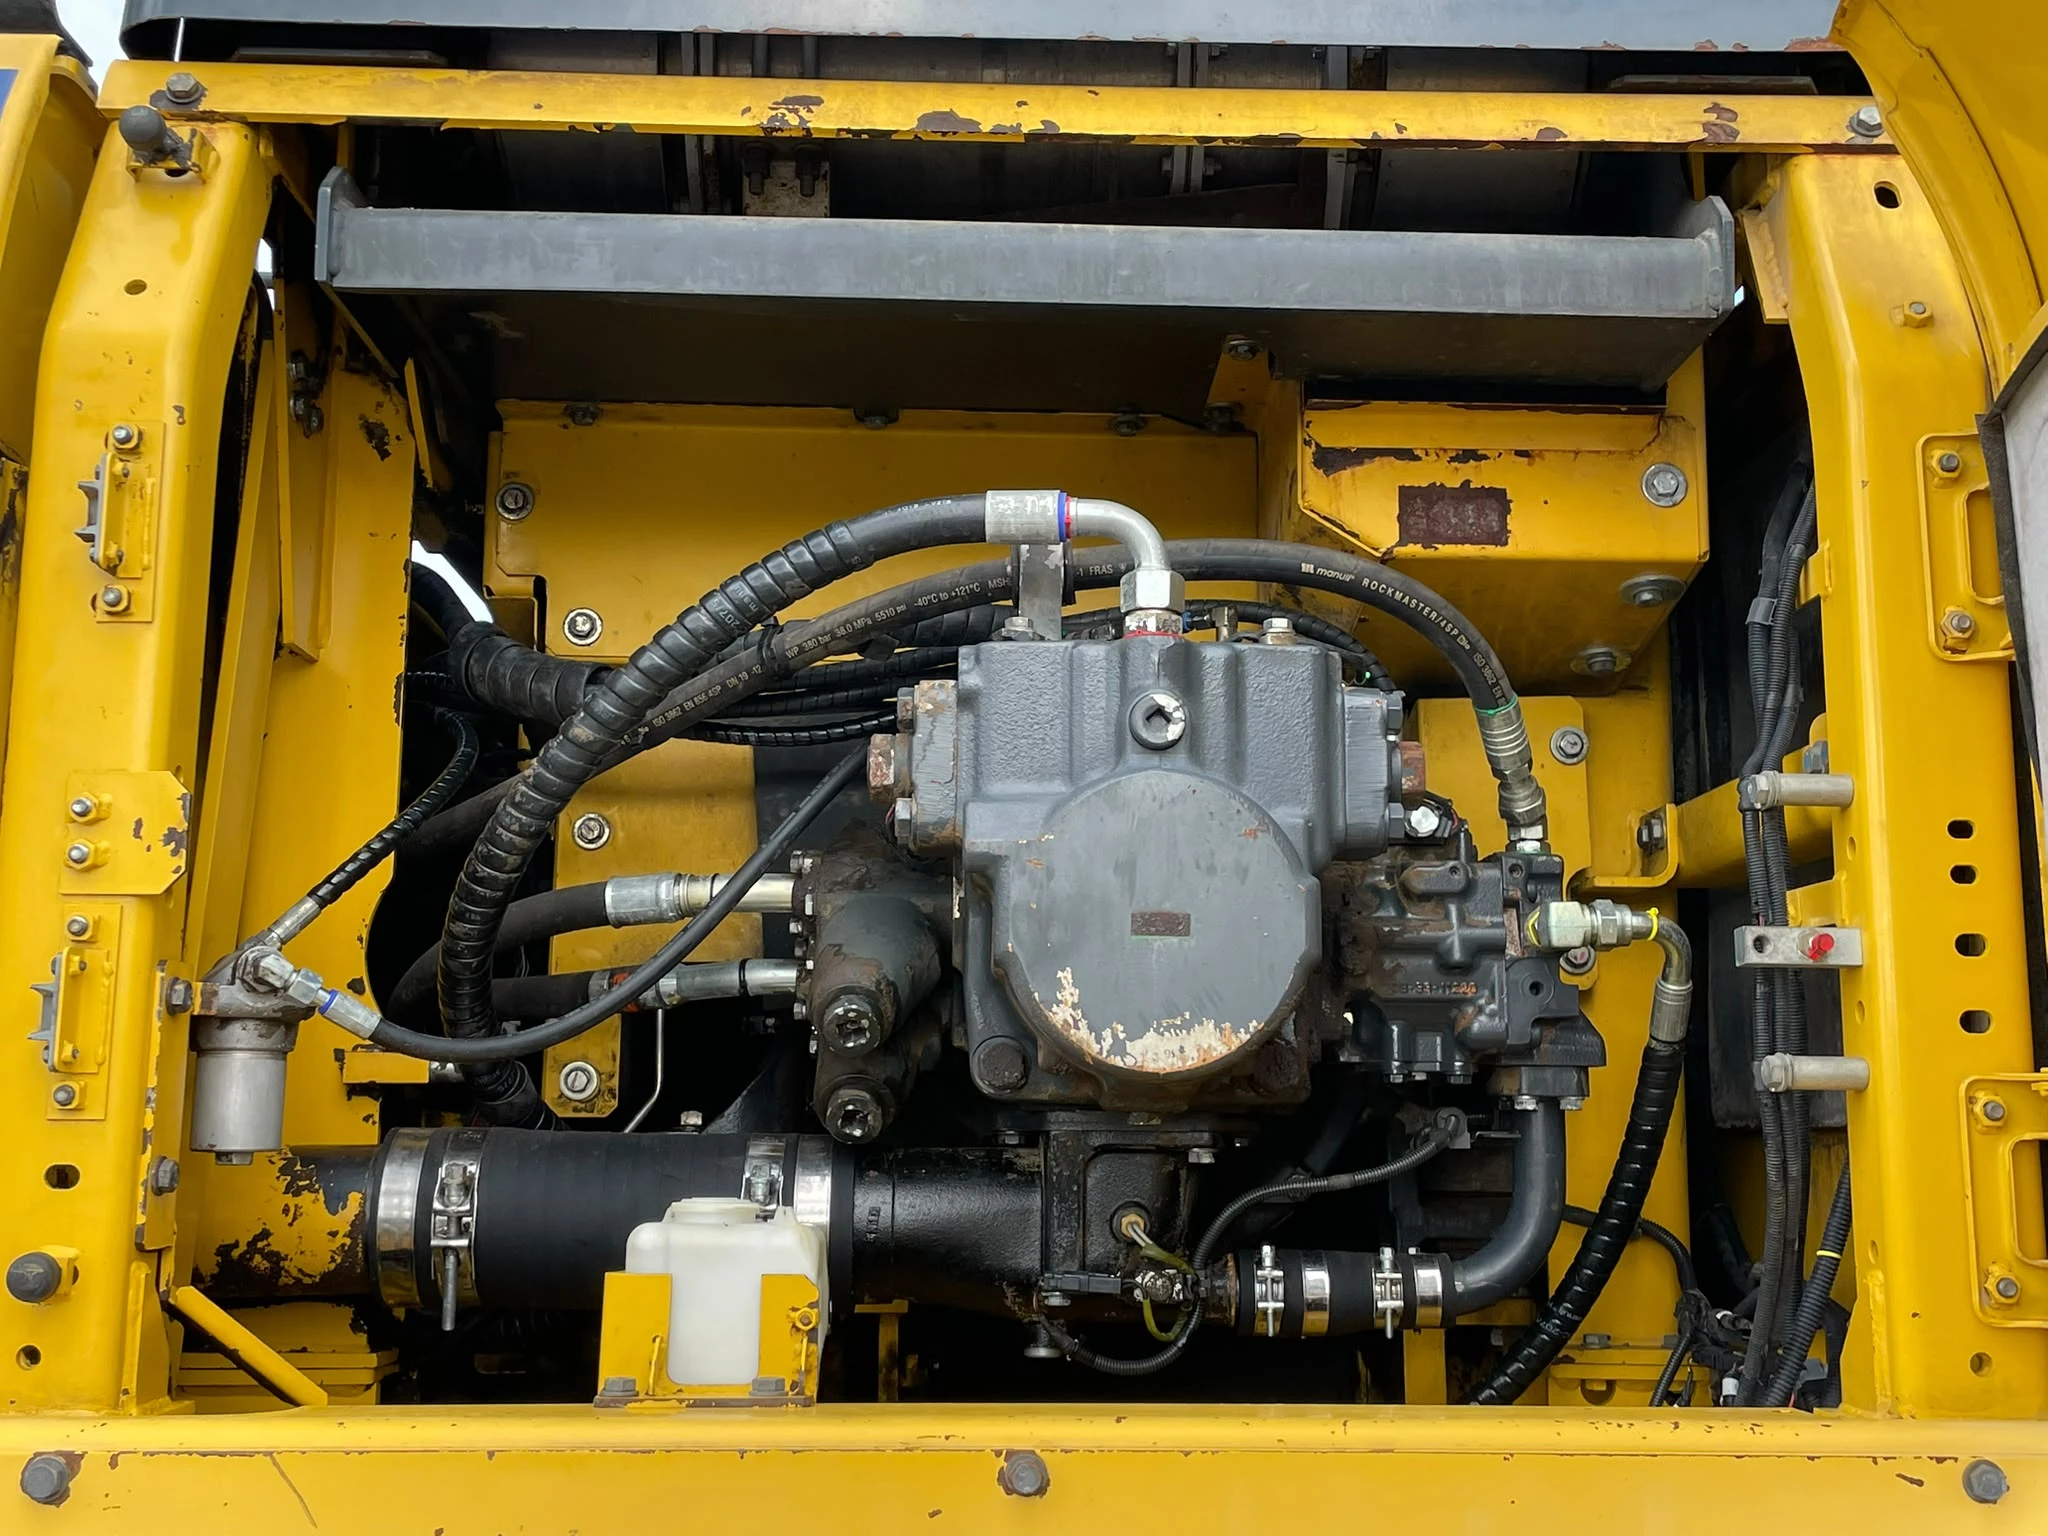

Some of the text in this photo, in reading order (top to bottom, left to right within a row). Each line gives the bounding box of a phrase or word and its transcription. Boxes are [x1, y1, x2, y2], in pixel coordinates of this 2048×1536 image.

[913, 589, 939, 608] -40°C
[939, 591, 949, 601] to
[951, 583, 981, 598] +121°C
[1089, 564, 1114, 576] FRAS
[785, 646, 800, 659] WP
[802, 638, 817, 652] 380
[818, 632, 832, 645] bar
[834, 624, 853, 638] 38.0
[853, 617, 873, 631] MPa
[875, 607, 896, 622] 5510
[1361, 576, 1458, 637] ROCKMASTER/4SP
[1472, 652, 1487, 669] ISO
[652, 716, 666, 728] ISO
[683, 699, 695, 712] EN
[708, 685, 722, 699] 4SP
[726, 677, 739, 689] DN
